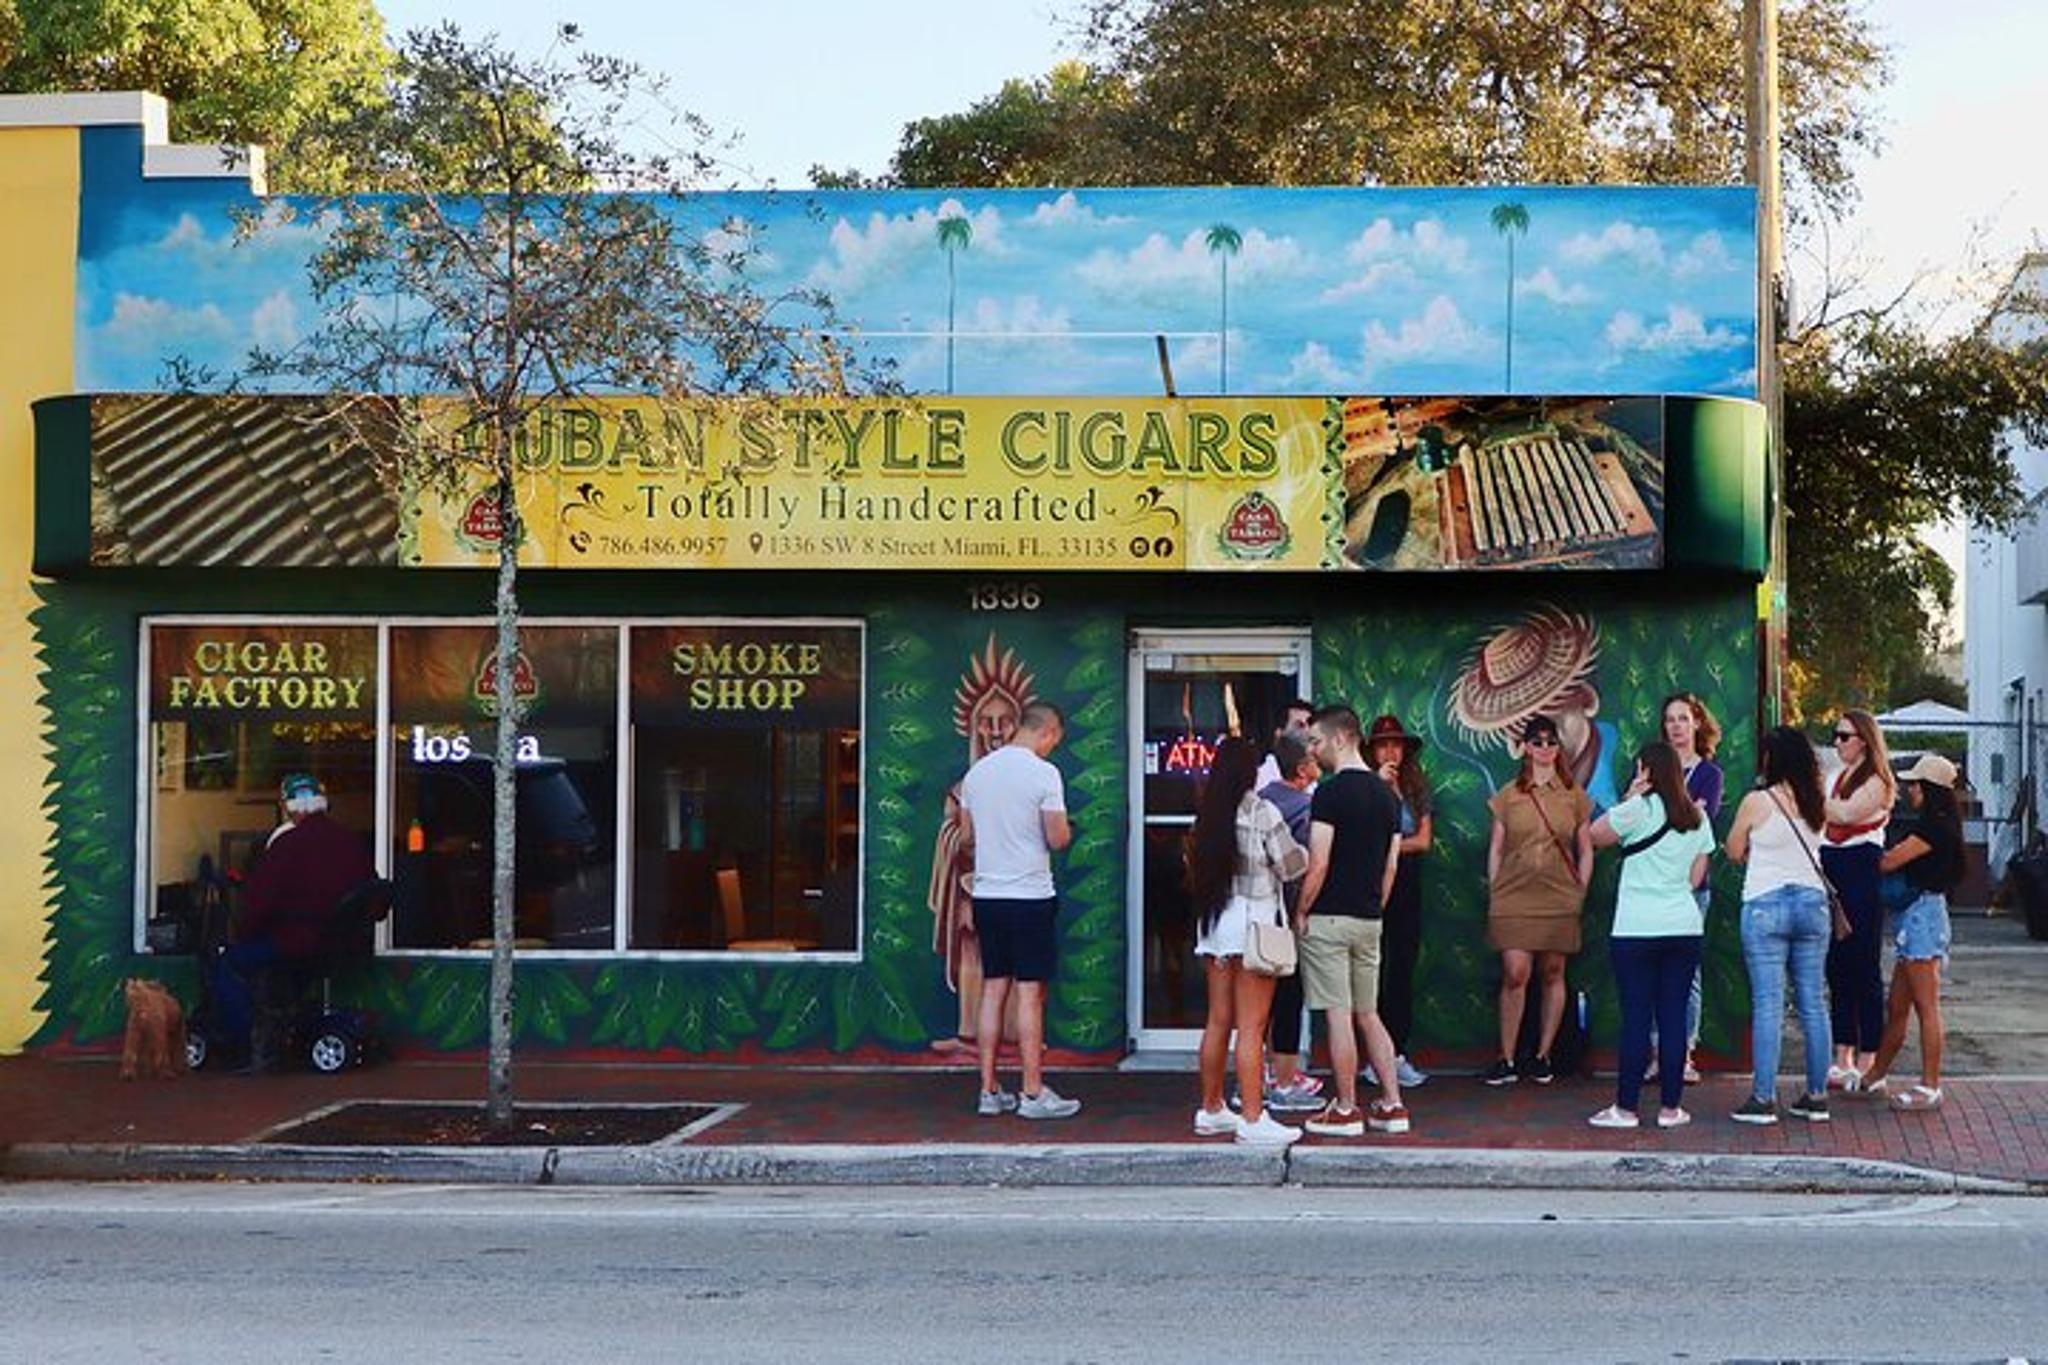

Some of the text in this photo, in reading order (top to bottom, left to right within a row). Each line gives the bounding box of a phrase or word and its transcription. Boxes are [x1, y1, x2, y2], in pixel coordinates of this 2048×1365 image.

[739, 408, 967, 471] STYLE
[1001, 411, 1279, 474] CIGARS
[637, 485, 1096, 529] Totally Handcrafted
[600, 536, 728, 555] 786.486.9957
[770, 536, 814, 554] 1336
[821, 537, 856, 554] SW
[862, 537, 874, 554] 8
[881, 537, 935, 555] Street
[943, 537, 1012, 557] Miami,
[1059, 537, 1118, 557] 33135
[967, 581, 1041, 610] 1336
[194, 642, 329, 672] CIGAR
[673, 643, 821, 675] SMOKE
[169, 676, 365, 709] FACTORY
[690, 679, 806, 710] SHOP
[413, 725, 471, 762] los
[1166, 742, 1216, 768] ATM
